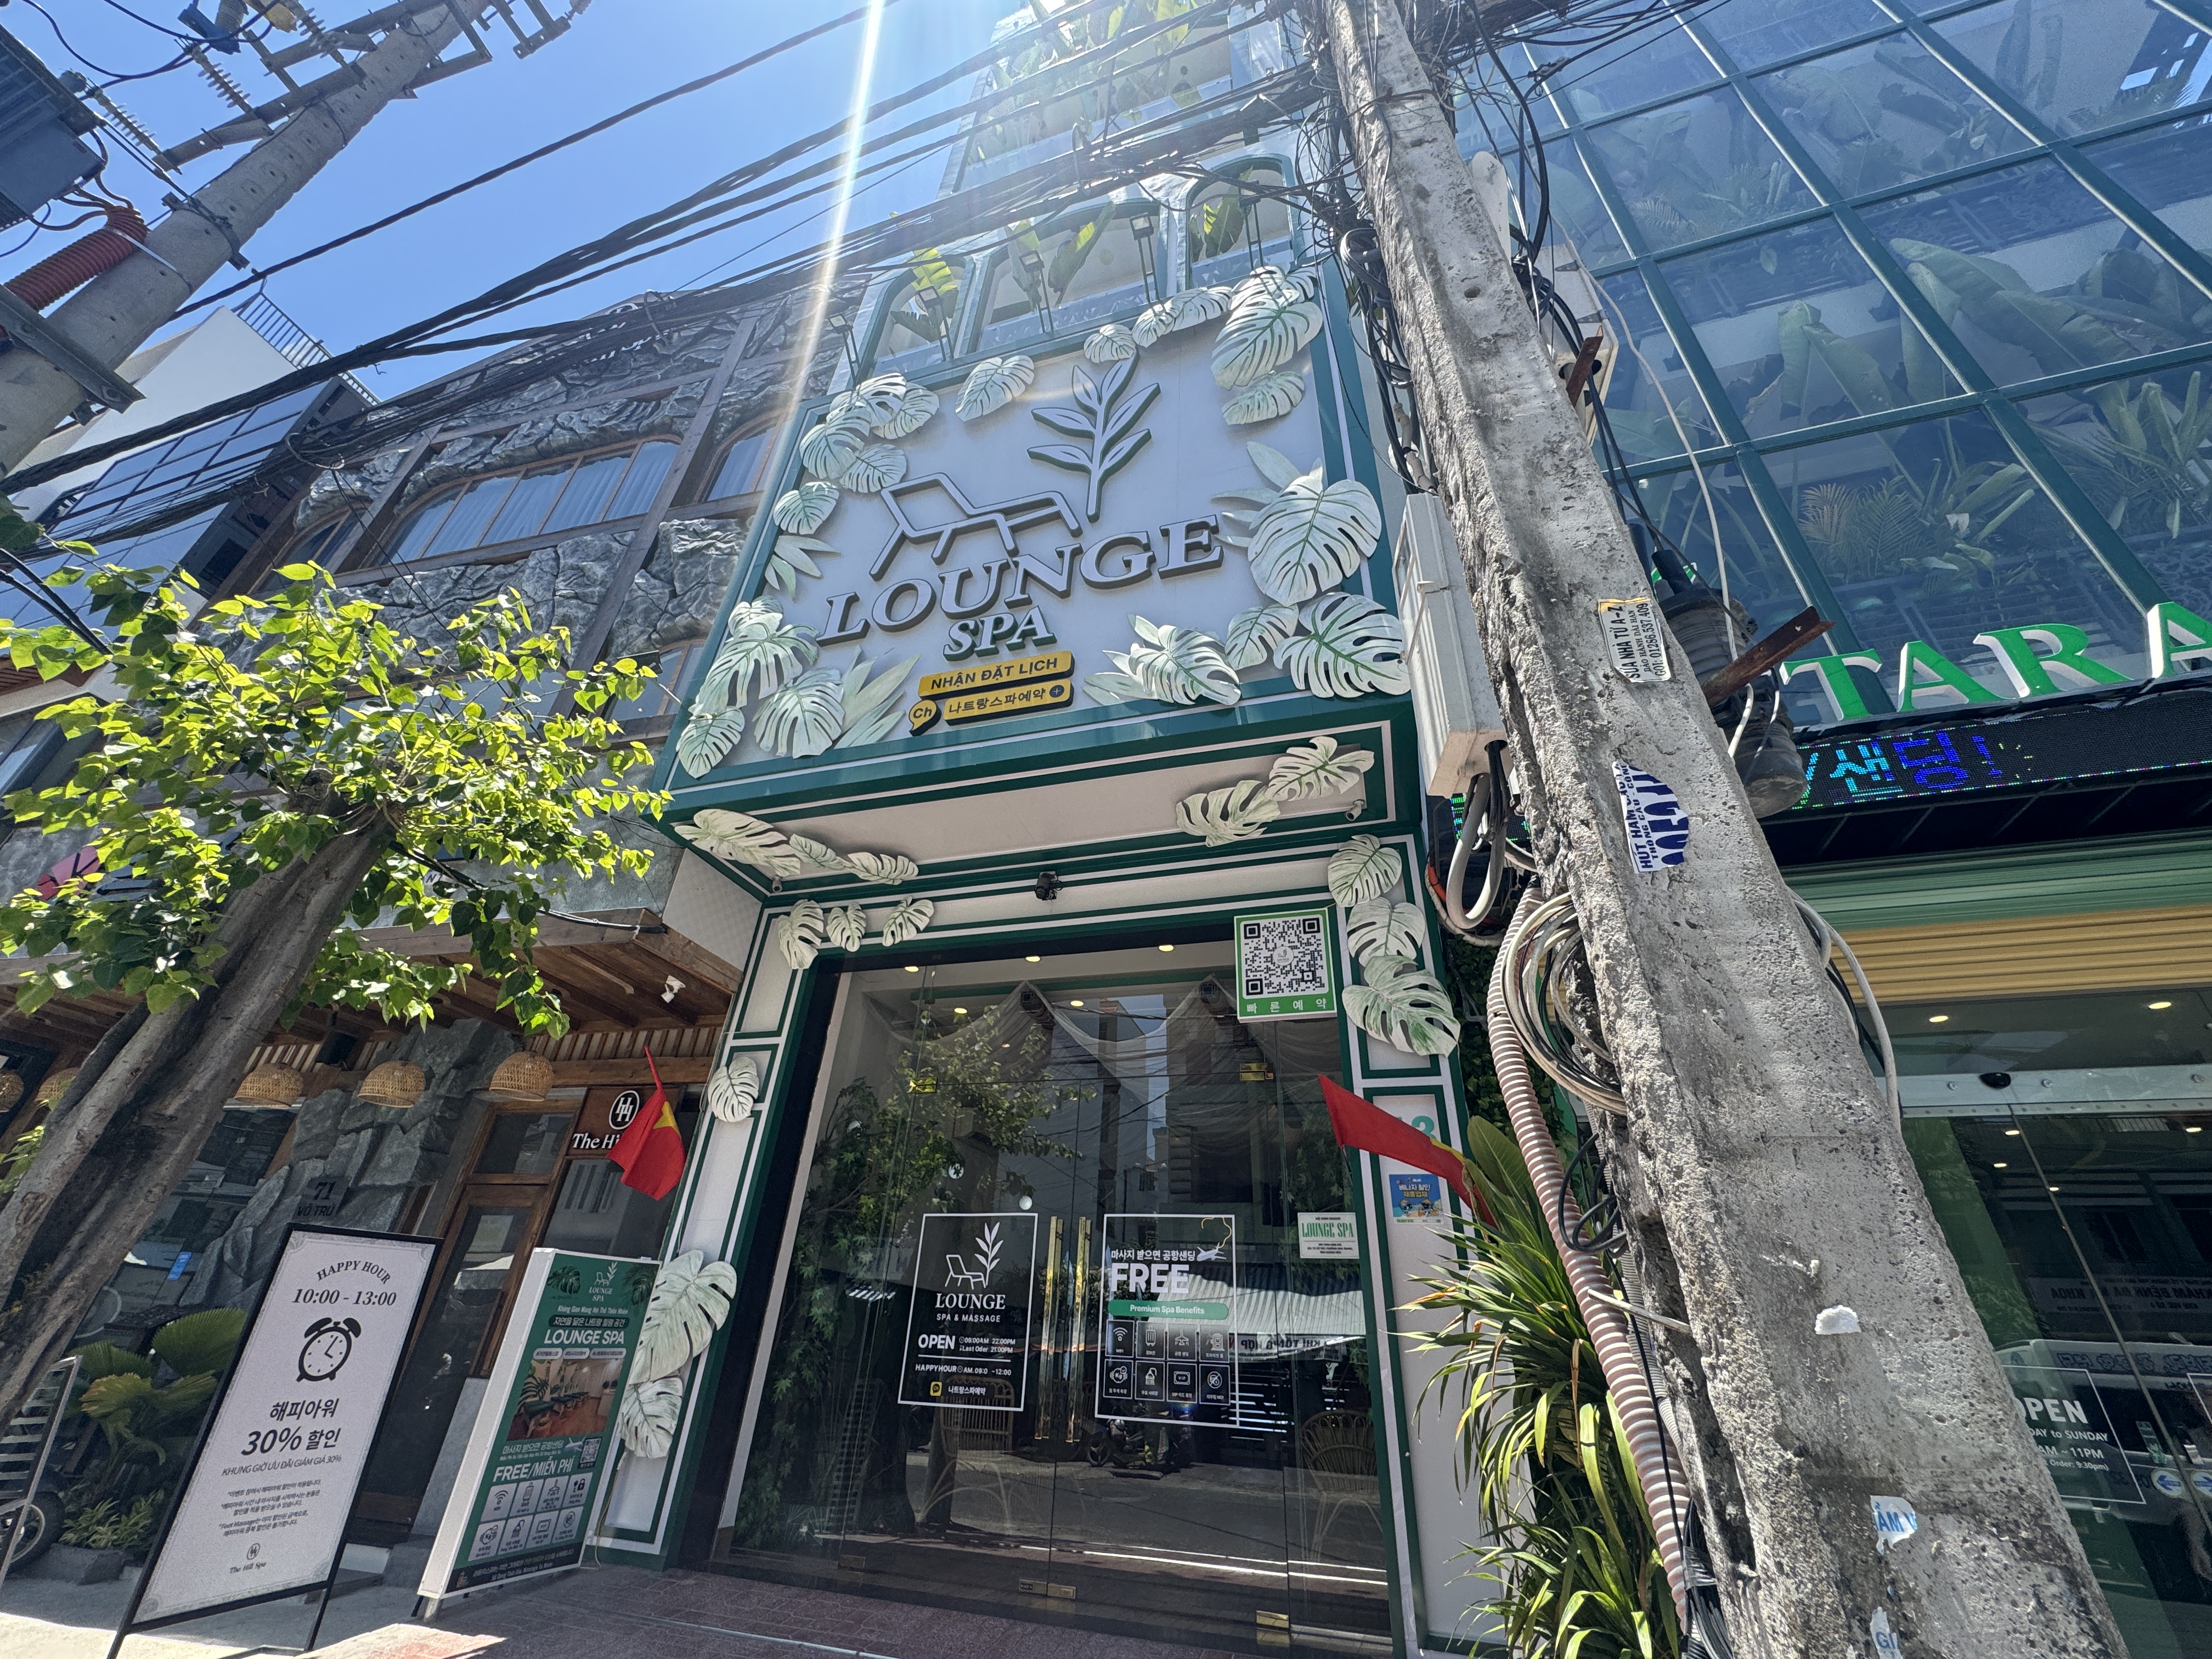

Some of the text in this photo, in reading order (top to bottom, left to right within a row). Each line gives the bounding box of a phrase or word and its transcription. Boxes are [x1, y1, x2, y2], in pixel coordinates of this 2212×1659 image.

[816, 514, 1223, 646] LOUNGE
[943, 605, 1057, 662] SPA
[1635, 603, 1661, 658] 01286.537.409
[1612, 641, 1635, 659] NHÀ
[931, 658, 1058, 690] NHẬN ĐẶT LỊCH
[949, 687, 1046, 713] 나트랑스파예약
[913, 707, 932, 719] Ch
[1641, 824, 1658, 860] THÔNG
[1634, 843, 1653, 868] HÚT
[572, 1132, 600, 1149] The
[1302, 1223, 1354, 1238] LOUNGE SPA
[1111, 1249, 1195, 1262] 마사지 받으면 공항샌딩
[317, 1260, 391, 1285] HAPPY HOUR
[1110, 1263, 1189, 1294] FREE
[292, 1289, 340, 1304] 10:00
[352, 1290, 397, 1306] 13:00
[935, 1293, 1006, 1310] LOUNGE
[1130, 1304, 1205, 1314] Premium Spa Benefits
[553, 1317, 572, 1325] 자연을
[585, 1318, 602, 1327] 나트랑
[602, 1318, 614, 1327] 힐링
[614, 1318, 625, 1327] 공간
[962, 1314, 1001, 1323] MASSAGE
[544, 1329, 624, 1344] LOUNGE SPA
[918, 1334, 956, 1350] OPEN
[948, 1386, 986, 1395] 나트랑스파예약
[270, 1398, 340, 1421] 해피아워
[2023, 1397, 2088, 1424] PEN
[241, 1426, 341, 1455] 30% 할인
[2051, 1430, 2062, 1438] to
[2064, 1431, 2108, 1442] SUNDAY
[502, 1440, 565, 1454] 마사지 받으면 공항샌딩
[2070, 1447, 2105, 1459] 11PM
[222, 1465, 252, 1476] KHUNG
[326, 1454, 342, 1463] 30%
[557, 1455, 575, 1474] PHÍ
[2050, 1459, 2109, 1472] Order: 9:30pm)
